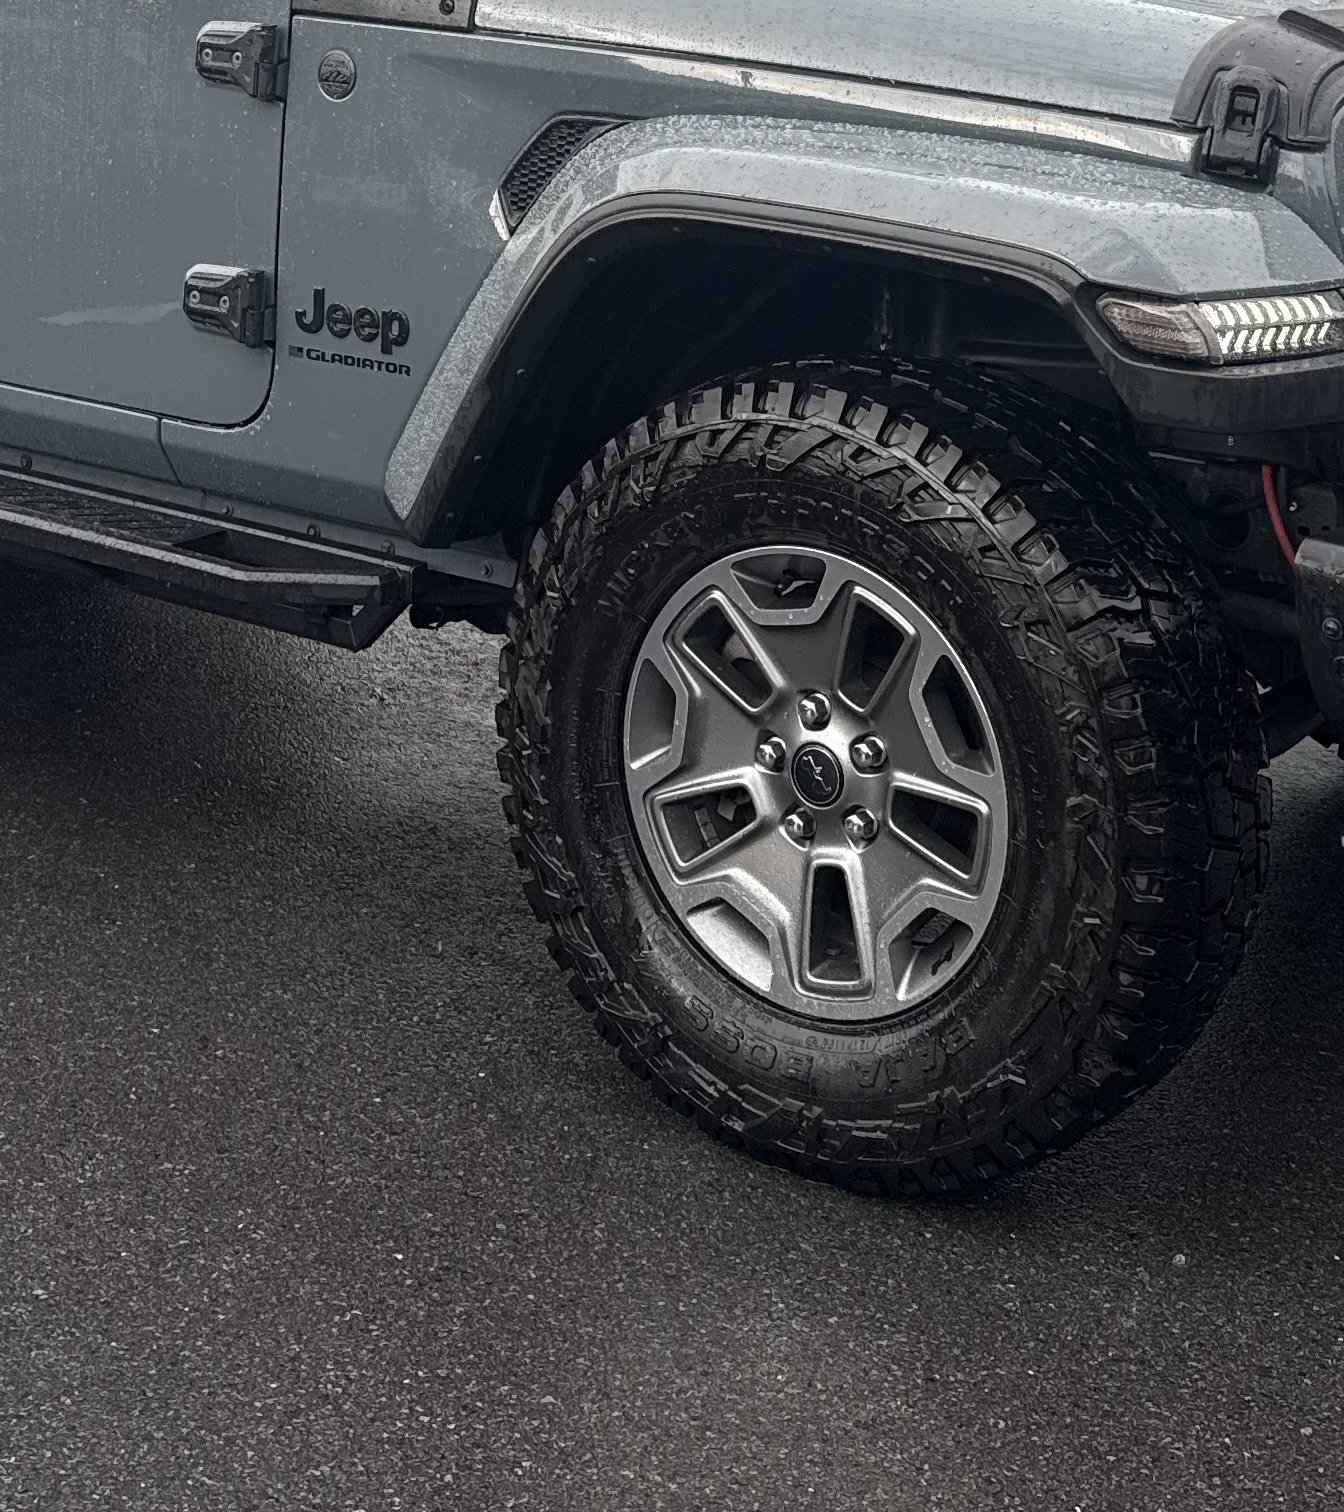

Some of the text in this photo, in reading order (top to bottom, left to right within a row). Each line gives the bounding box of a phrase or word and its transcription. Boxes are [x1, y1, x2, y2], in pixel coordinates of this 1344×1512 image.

[295, 287, 410, 354] Jeep
[306, 347, 411, 376] GLADIATOR
[684, 996, 813, 1083] BOSS
